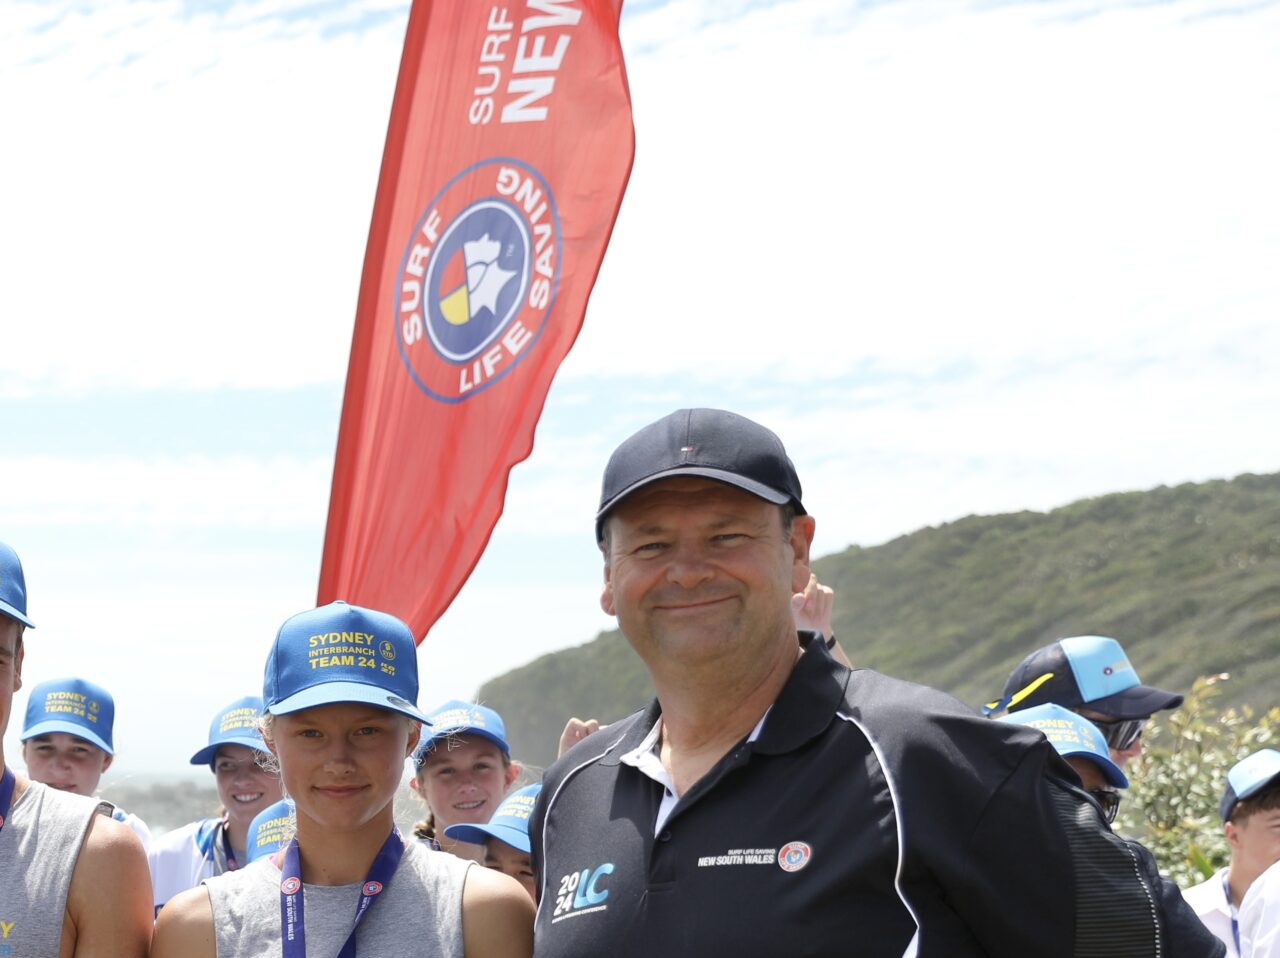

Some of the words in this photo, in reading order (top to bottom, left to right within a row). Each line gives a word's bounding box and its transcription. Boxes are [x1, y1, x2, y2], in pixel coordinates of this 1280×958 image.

[469, 7, 514, 125] SURF
[496, 166, 555, 310] SAVING
[399, 210, 443, 345] SURF
[459, 320, 534, 394] LIFE
[309, 632, 374, 647] SYDNEY
[309, 646, 375, 658] INTERBRANCH
[309, 656, 355, 669] TEAM
[358, 656, 376, 669] 24
[47, 692, 87, 702] SYDNEY
[45, 705, 72, 713] TEAM
[73, 708, 86, 717] 24
[698, 856, 716, 867] NEW
[716, 855, 743, 866] SOUTH
[744, 854, 775, 865] WALES
[558, 871, 580, 896] 20
[553, 892, 574, 917] 24
